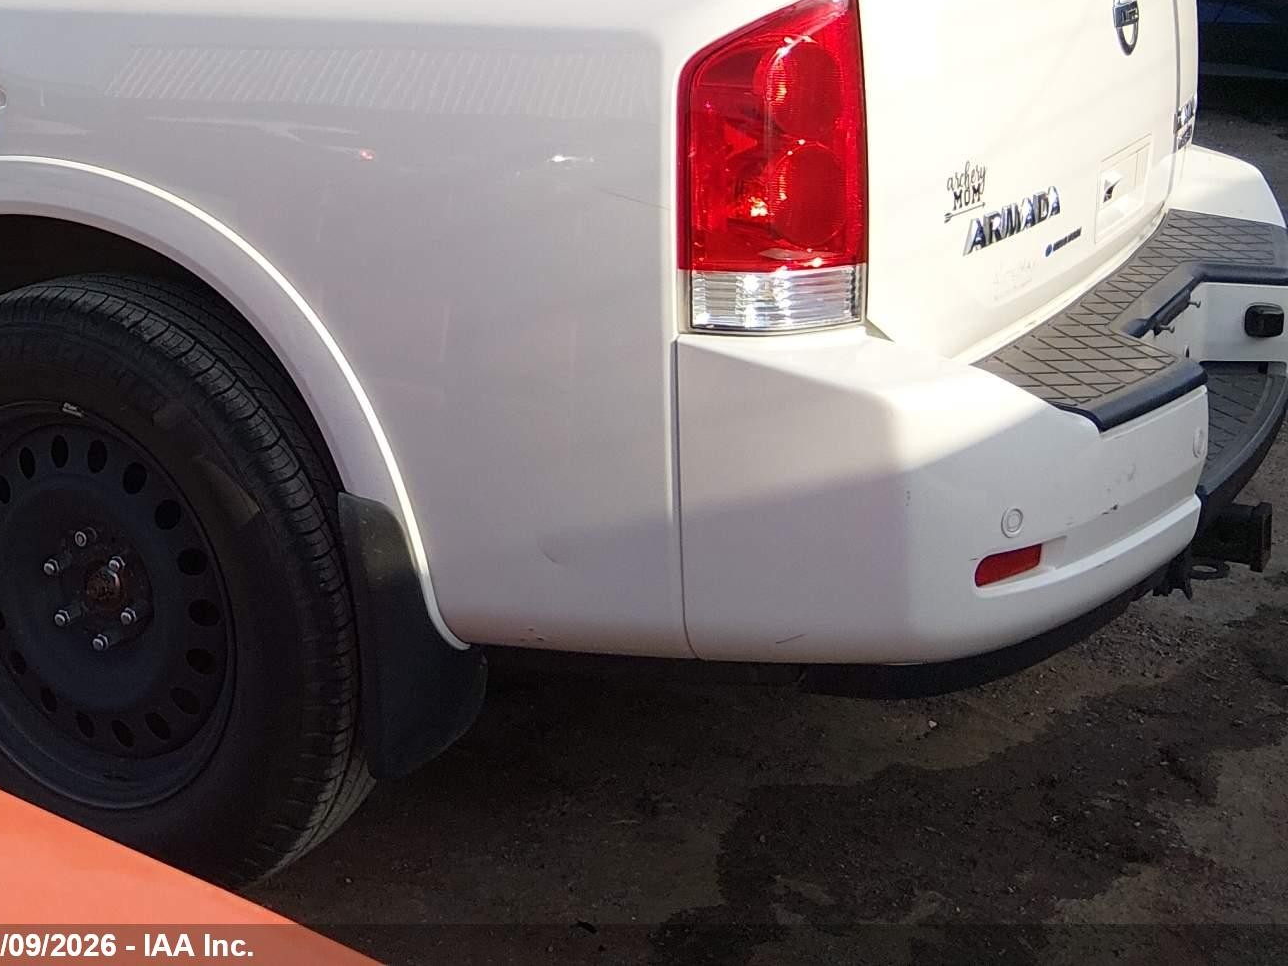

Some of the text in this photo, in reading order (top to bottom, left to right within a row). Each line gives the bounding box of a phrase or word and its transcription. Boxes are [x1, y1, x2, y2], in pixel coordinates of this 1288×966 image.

[946, 160, 987, 195] archery
[952, 183, 981, 211] MOM
[963, 185, 1061, 257] ARMADA
